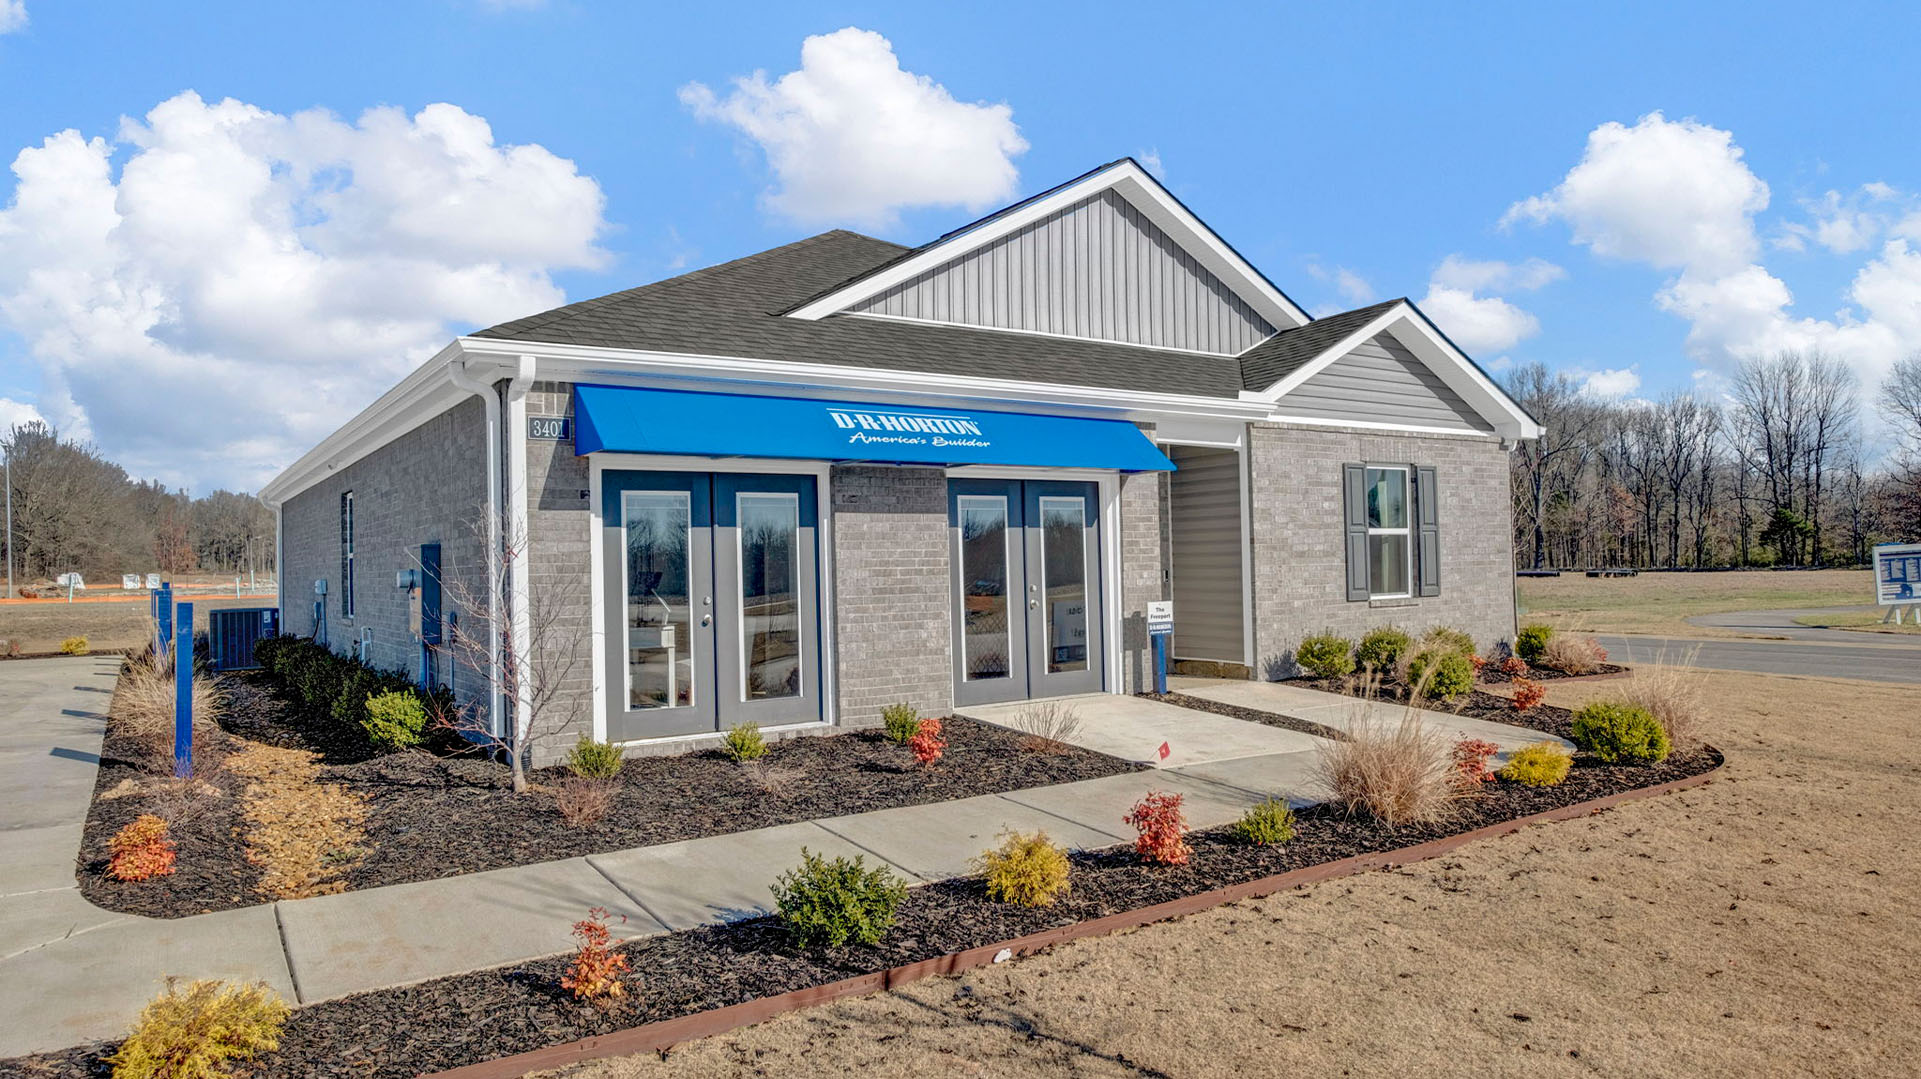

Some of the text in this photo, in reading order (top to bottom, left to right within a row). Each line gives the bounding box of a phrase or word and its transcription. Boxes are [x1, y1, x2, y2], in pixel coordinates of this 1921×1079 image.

[533, 420, 565, 438] 3401
[849, 431, 991, 448] America's Builder
